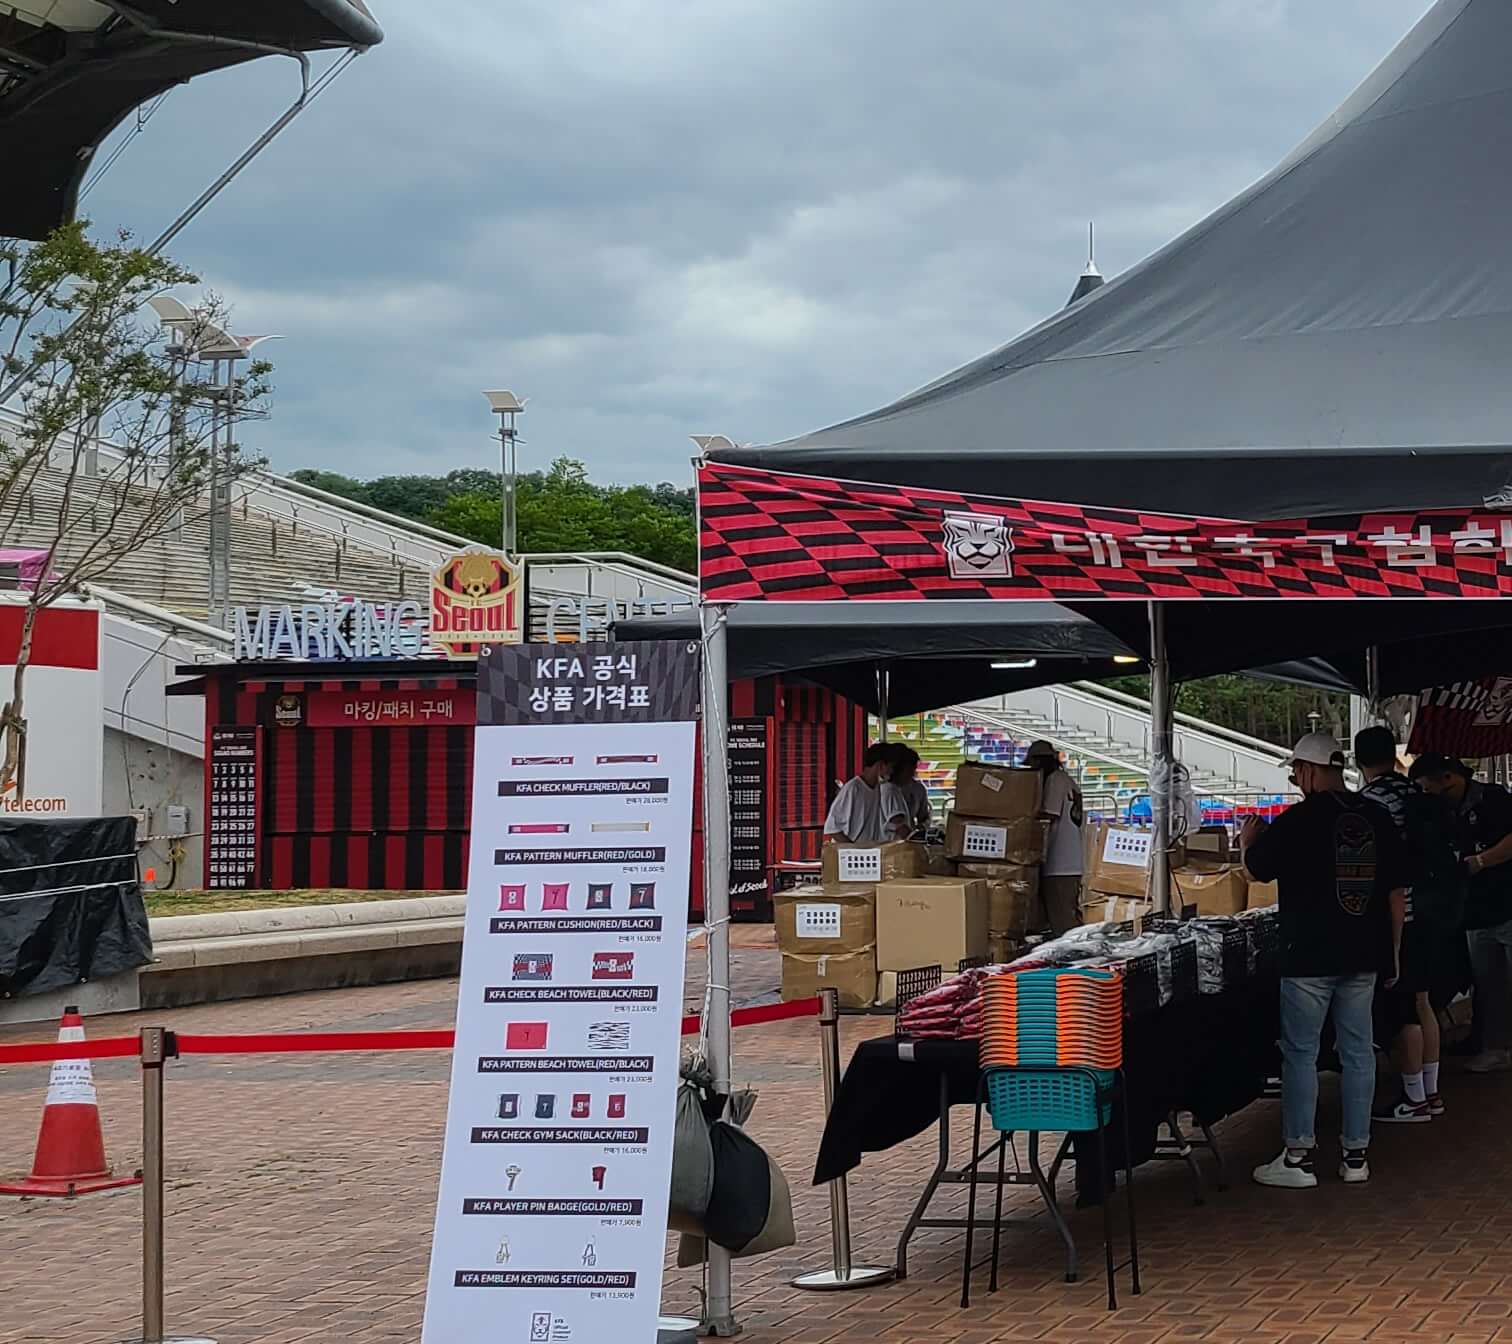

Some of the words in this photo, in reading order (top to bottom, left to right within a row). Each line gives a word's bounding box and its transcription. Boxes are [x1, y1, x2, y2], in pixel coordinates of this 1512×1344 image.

[432, 587, 518, 632] Seoul
[233, 600, 421, 658] MARKING
[537, 657, 584, 679] KFA
[592, 654, 636, 680] 공식
[528, 686, 575, 712] 상품
[582, 685, 650, 710] 가격표
[344, 700, 414, 721] 마킹/패치
[420, 700, 453, 719] 구매
[516, 784, 532, 793] KFA
[533, 784, 561, 792] CHECK
[562, 783, 650, 792] MUFFLER(RED/BLACK)
[5, 797, 66, 812] telecom
[505, 853, 521, 861] KFA
[524, 852, 562, 860] PATTERN
[564, 850, 655, 860] MUFFLER(RED/GOLD)
[498, 921, 516, 929] KFA
[517, 920, 556, 929] PATTERN
[558, 919, 653, 929] CUSHION(RED/BLACK)
[489, 991, 506, 999] KFA
[508, 990, 536, 998] CHECK
[538, 990, 566, 998] BEACH
[569, 989, 652, 999] TOWEL(BLACK/RED)
[482, 1060, 499, 1068] KFA
[501, 1060, 536, 1068] PATTERN
[538, 1060, 565, 1068] BEACH
[568, 1059, 649, 1069] TOWEL(RED/BLACK)
[482, 1131, 499, 1139] KFA
[501, 1131, 531, 1139] CHECK
[533, 1131, 554, 1139] GYM
[556, 1130, 637, 1140] SACK(BLACK/RED)
[474, 1202, 491, 1211] KFA
[494, 1202, 528, 1211] PLAYER
[530, 1202, 546, 1211] PIN
[548, 1201, 632, 1212] BADGE(GOLD/RED)
[462, 1274, 479, 1283] KFA
[481, 1274, 519, 1283] EMBLEM
[521, 1274, 559, 1283] KEYRING
[561, 1274, 629, 1285] SET(GOLD/RED)
